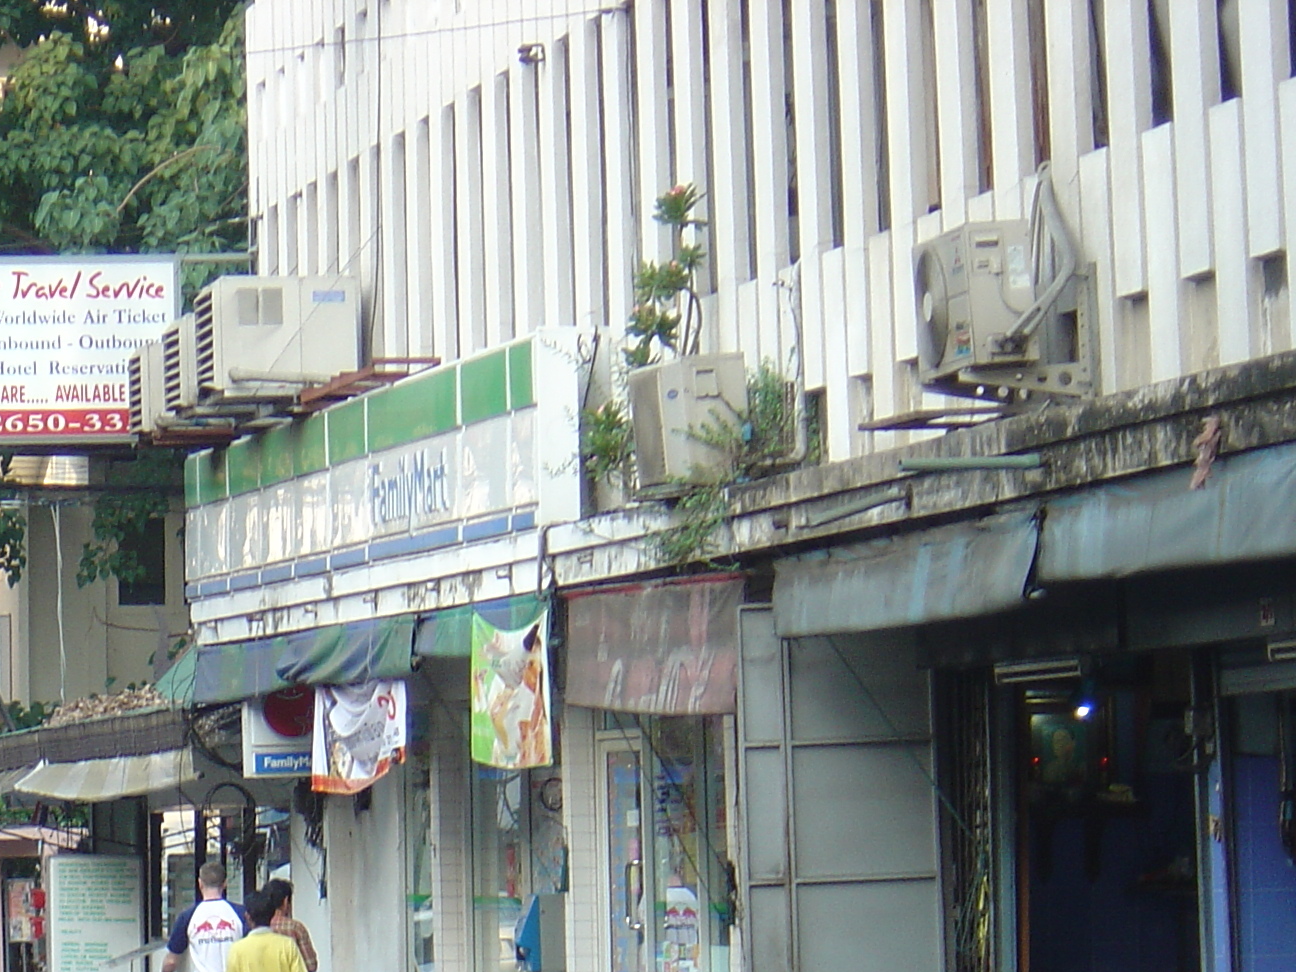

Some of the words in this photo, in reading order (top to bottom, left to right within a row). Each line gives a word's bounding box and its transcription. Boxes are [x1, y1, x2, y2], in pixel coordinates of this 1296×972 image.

[12, 270, 82, 300] Travel
[85, 271, 165, 300] Service
[83, 309, 109, 325] Air
[112, 308, 167, 325] Ticket
[49, 358, 130, 376] Reservati
[54, 383, 126, 403] AVAILABLE
[371, 447, 449, 535] FamilyMart
